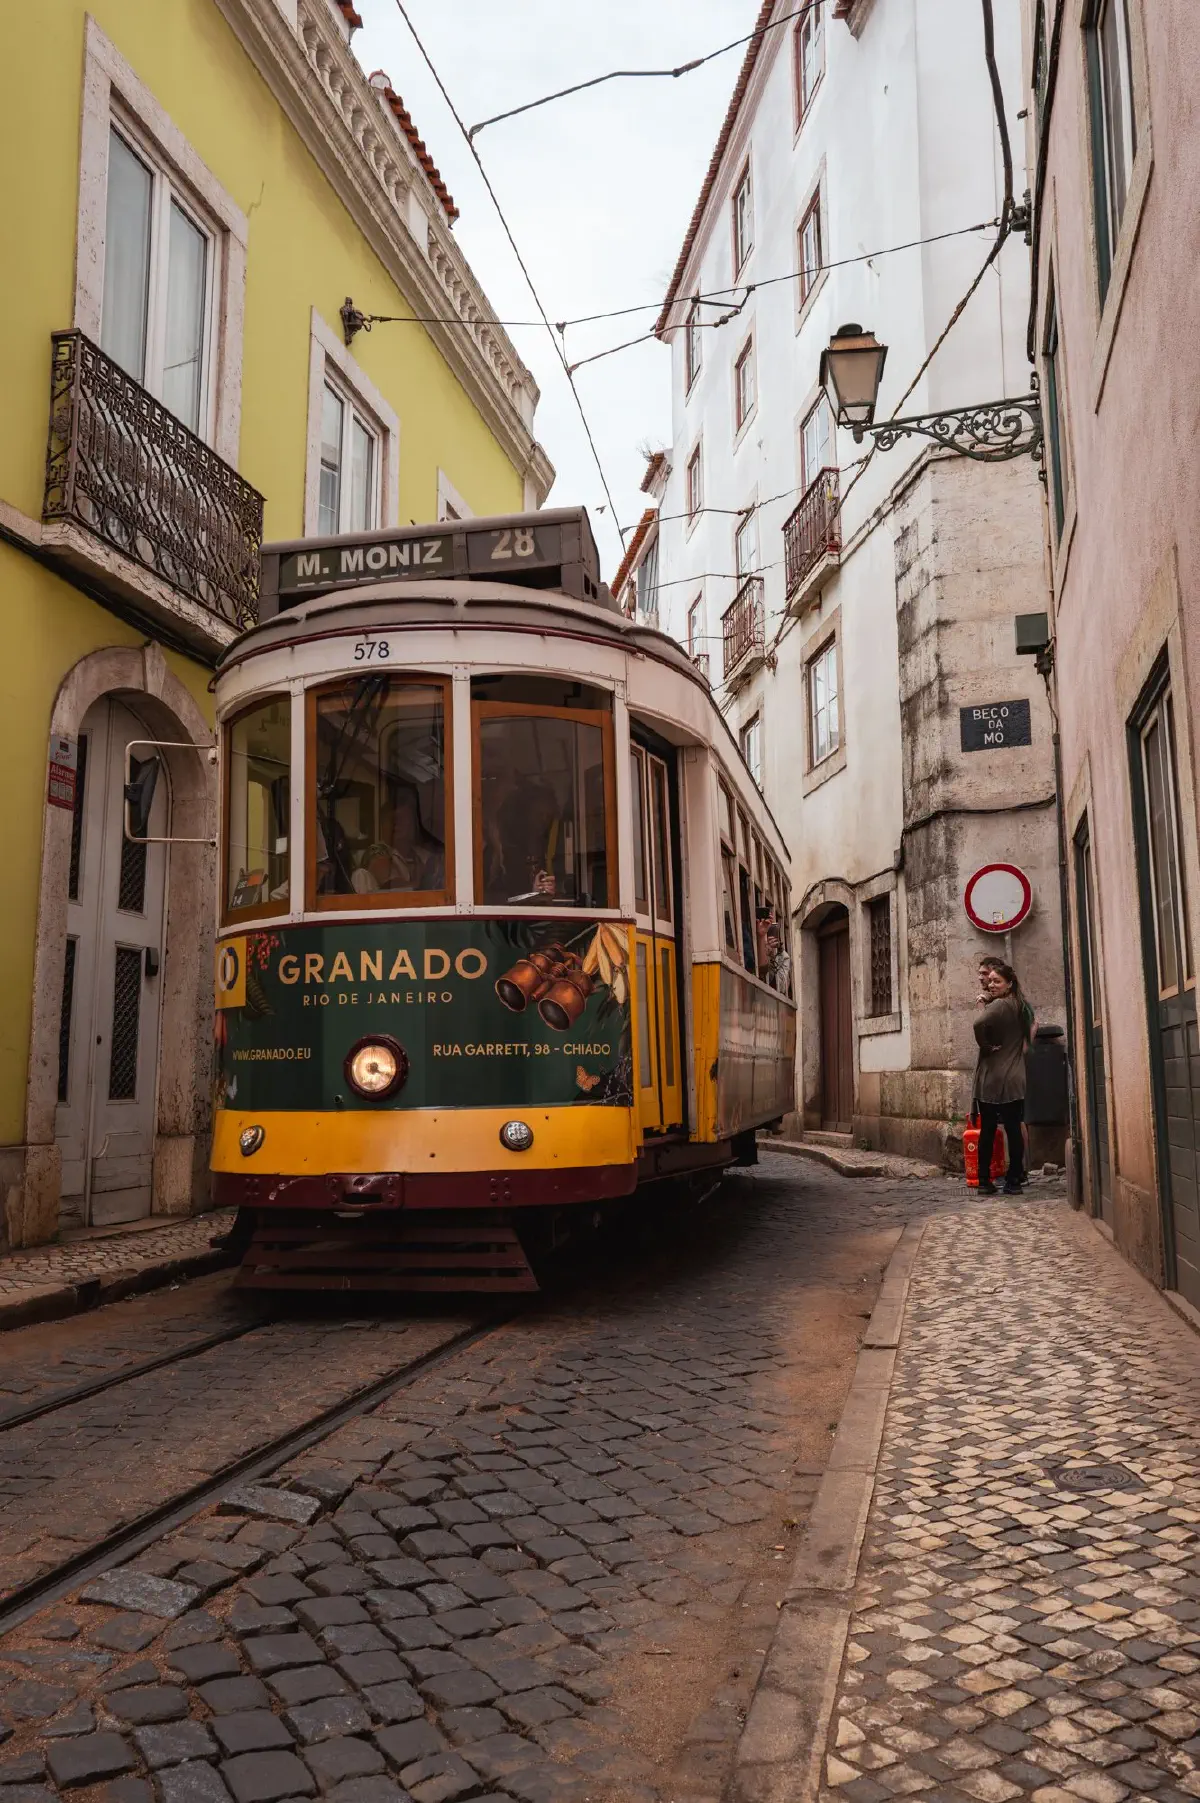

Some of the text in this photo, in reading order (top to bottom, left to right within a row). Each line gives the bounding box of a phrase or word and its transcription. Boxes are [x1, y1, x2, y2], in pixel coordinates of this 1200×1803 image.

[491, 528, 534, 559] 28
[297, 540, 443, 576] M. MONIZ
[354, 641, 391, 661] 578
[972, 706, 1009, 720] BECO
[988, 719, 1003, 729] DA
[277, 947, 488, 985] GRANADO
[303, 991, 454, 1006] RIO DE JANEIRO
[232, 1047, 312, 1061] WWW.GRANADO.EU
[433, 1044, 462, 1056] RUA
[464, 1043, 531, 1058] GARRETT,
[534, 1043, 551, 1056] 98
[563, 1042, 611, 1056] CHIADO
